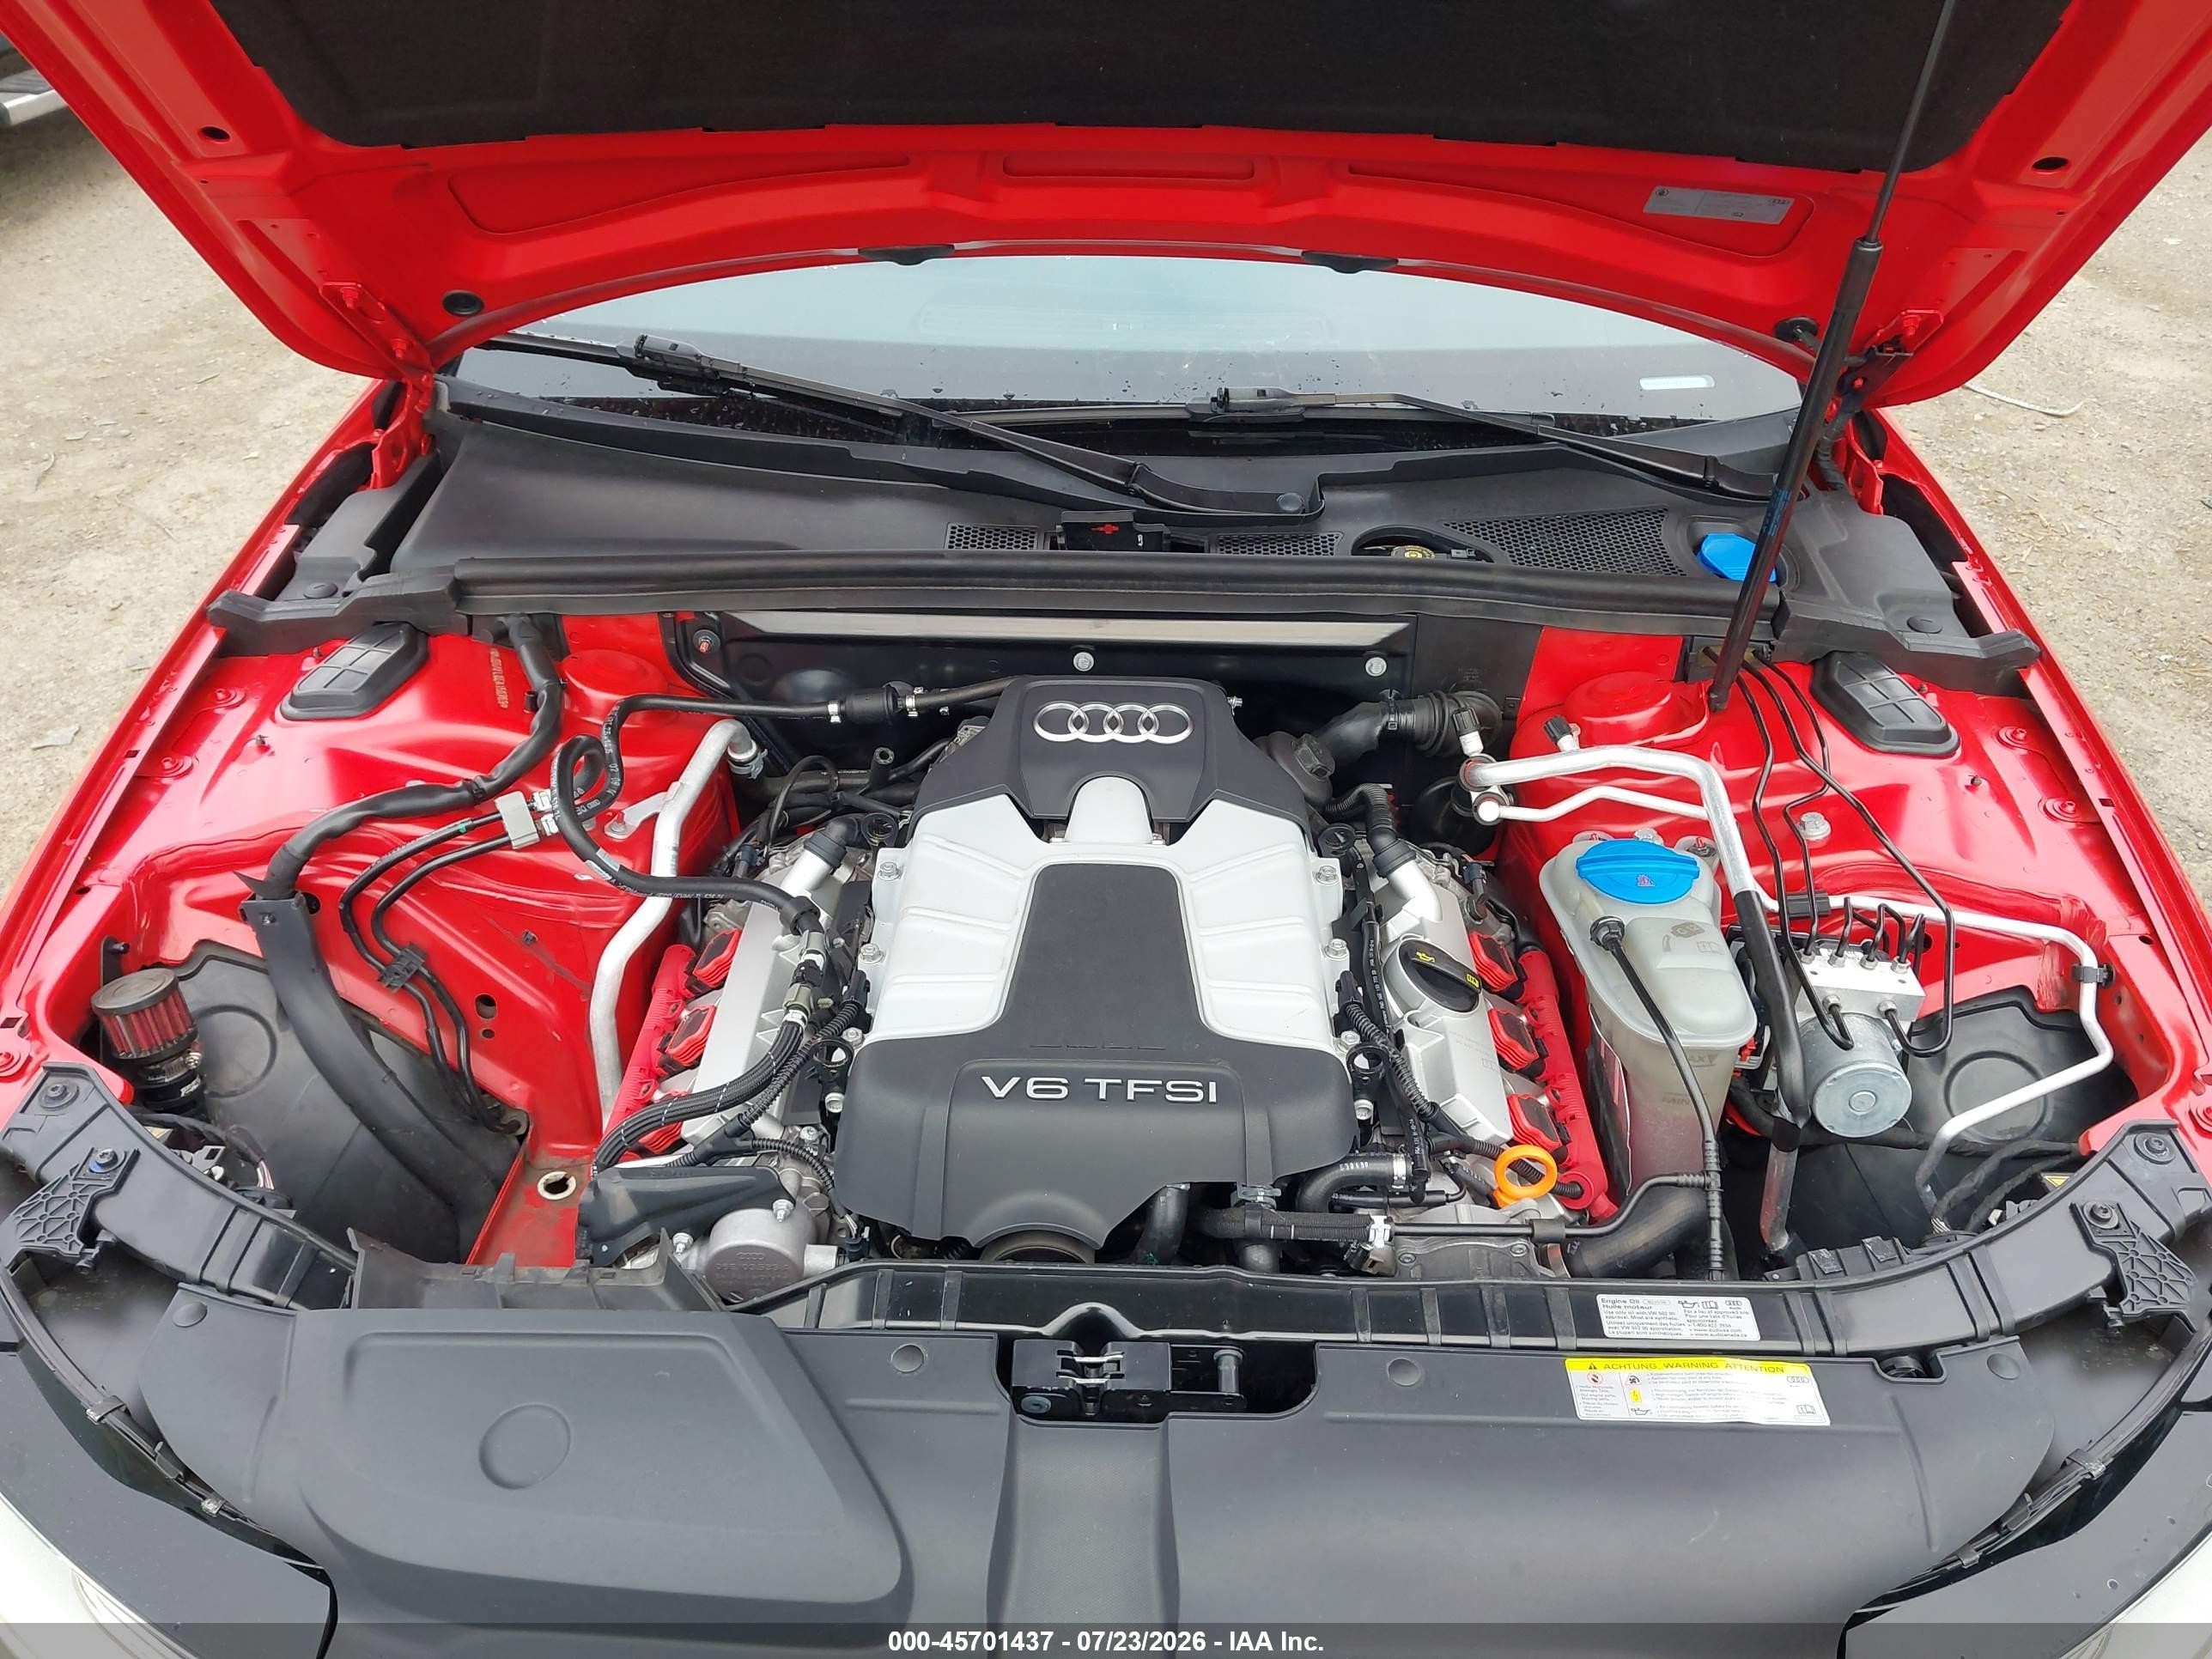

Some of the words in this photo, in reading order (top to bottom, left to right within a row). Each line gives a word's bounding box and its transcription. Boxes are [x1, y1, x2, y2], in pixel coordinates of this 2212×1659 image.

[981, 1076, 1070, 1100] V6
[1084, 1078, 1218, 1103] TFSI
[1724, 1364, 1784, 1374] ATTENTION
